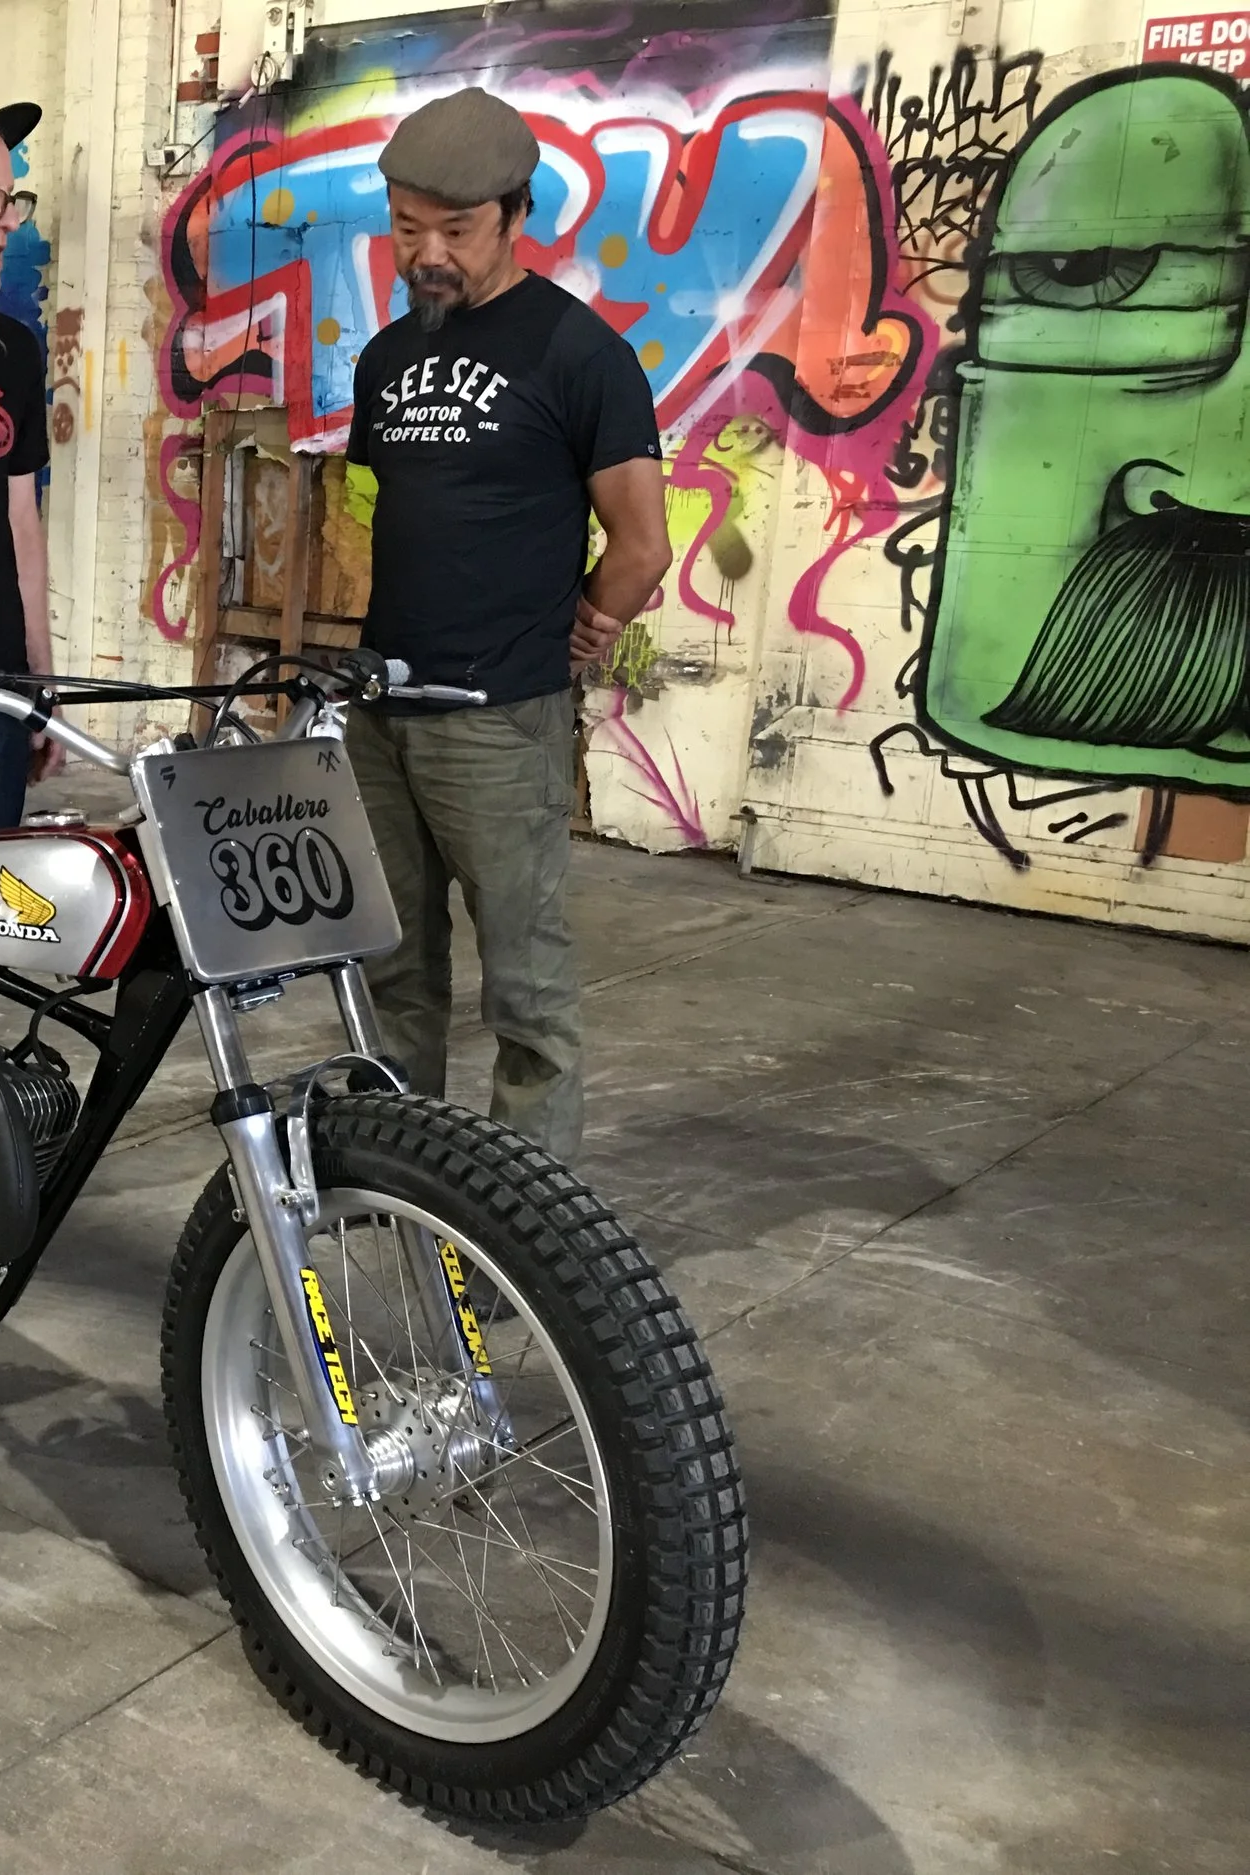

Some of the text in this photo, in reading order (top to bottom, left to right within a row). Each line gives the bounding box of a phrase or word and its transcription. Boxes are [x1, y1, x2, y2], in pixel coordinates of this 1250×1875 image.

[1148, 18, 1250, 49] FIRE DO
[380, 355, 509, 414] SEE SEE
[382, 426, 471, 443] COFFEE CO.
[401, 406, 462, 422] MOTOR
[478, 421, 500, 431] ORE
[194, 794, 331, 836] Caballero
[209, 827, 354, 932] 360
[440, 1241, 466, 1299] TEC
[301, 1268, 359, 1425] RACE TECH
